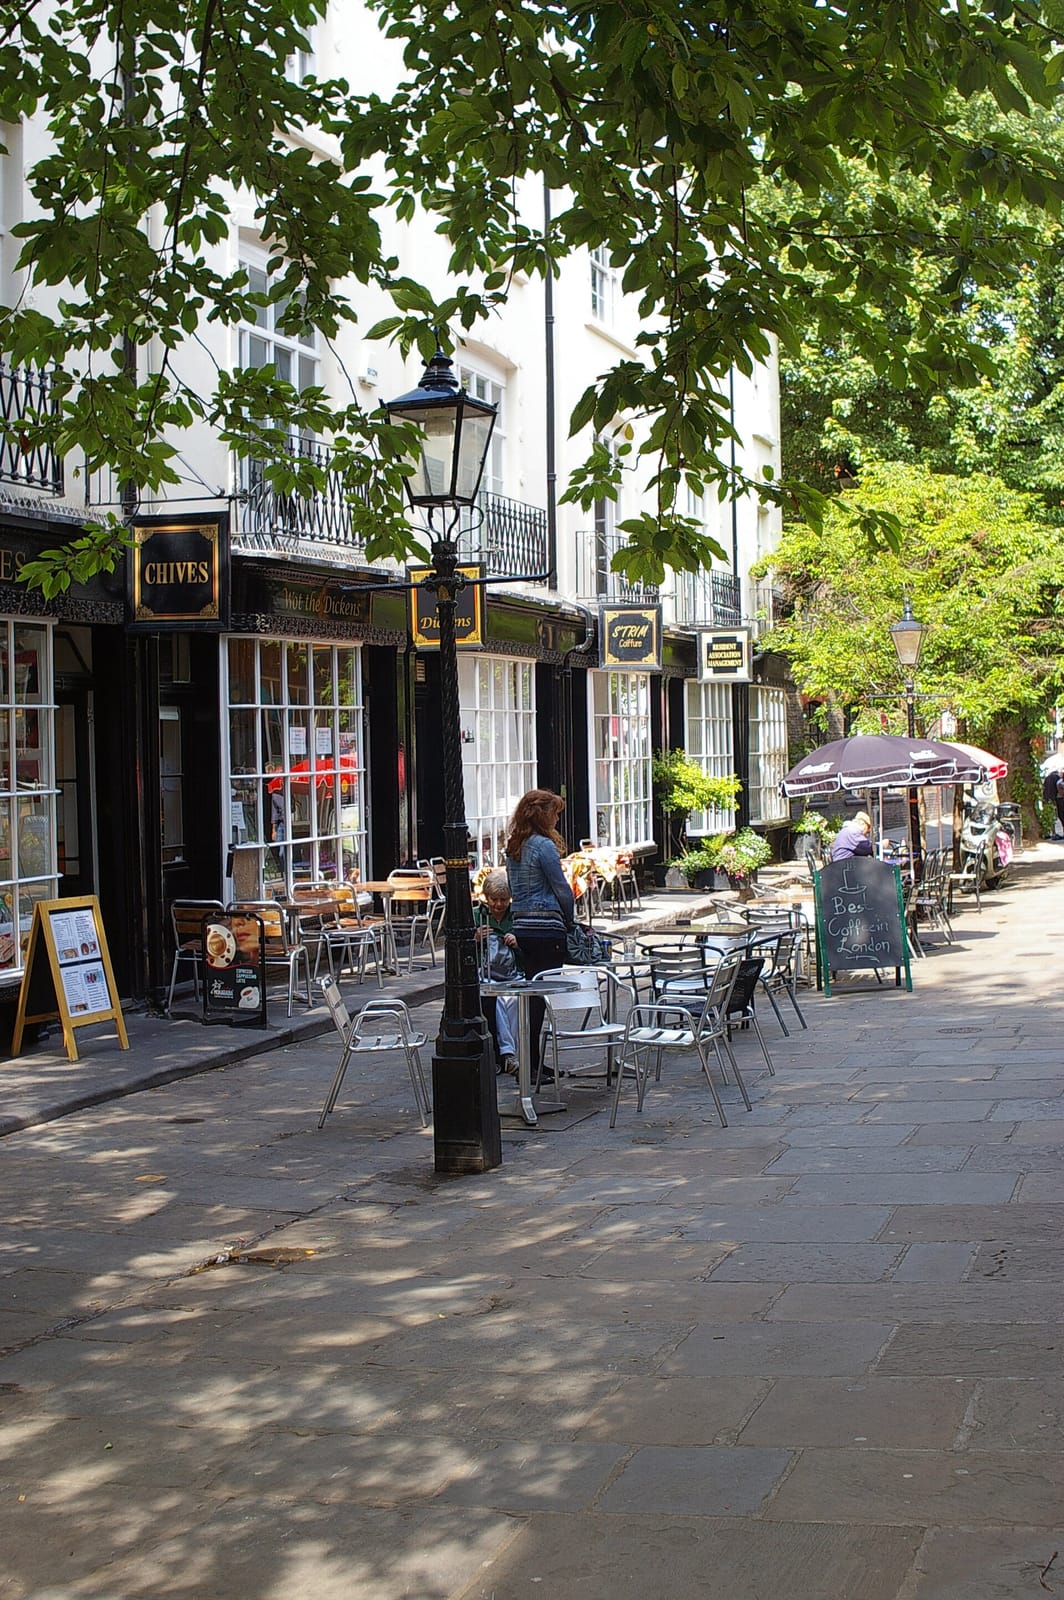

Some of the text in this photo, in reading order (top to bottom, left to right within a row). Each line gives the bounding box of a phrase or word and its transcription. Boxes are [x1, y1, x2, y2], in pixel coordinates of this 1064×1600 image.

[144, 561, 209, 585] CHIVES
[283, 588, 361, 617] Wot the Dickens
[612, 625, 649, 638] STRIM
[712, 643, 737, 651] RESIDENT
[709, 651, 741, 659] ASSOCIATION
[707, 659, 742, 667] MANAGEMENT
[832, 892, 874, 915] Best
[836, 936, 891, 954] London
